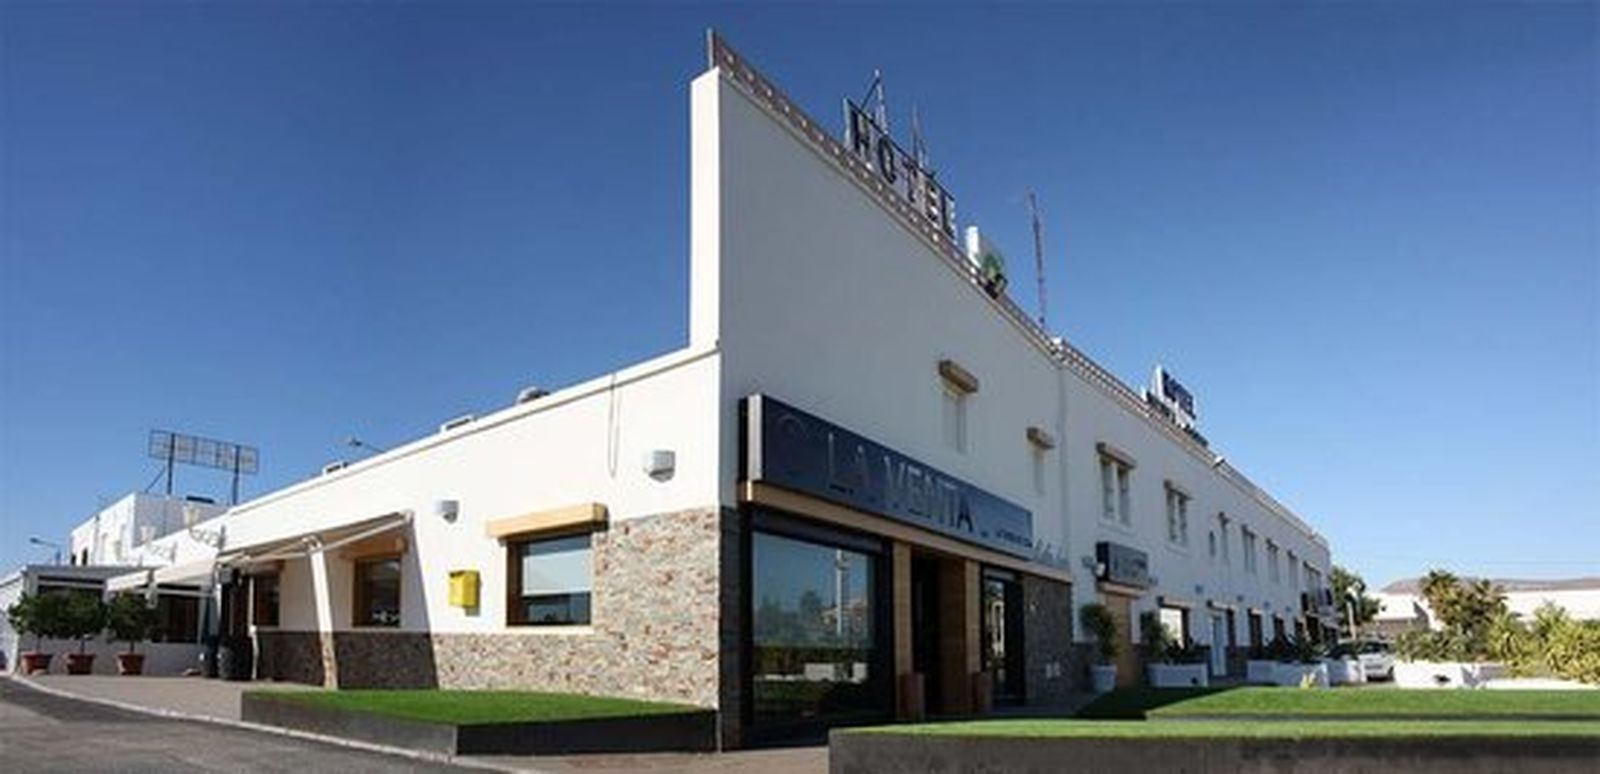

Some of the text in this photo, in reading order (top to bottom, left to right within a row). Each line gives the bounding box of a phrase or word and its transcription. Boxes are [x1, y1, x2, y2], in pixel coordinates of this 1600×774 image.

[849, 106, 956, 242] HOTEL
[827, 430, 975, 534] LA VENTA
